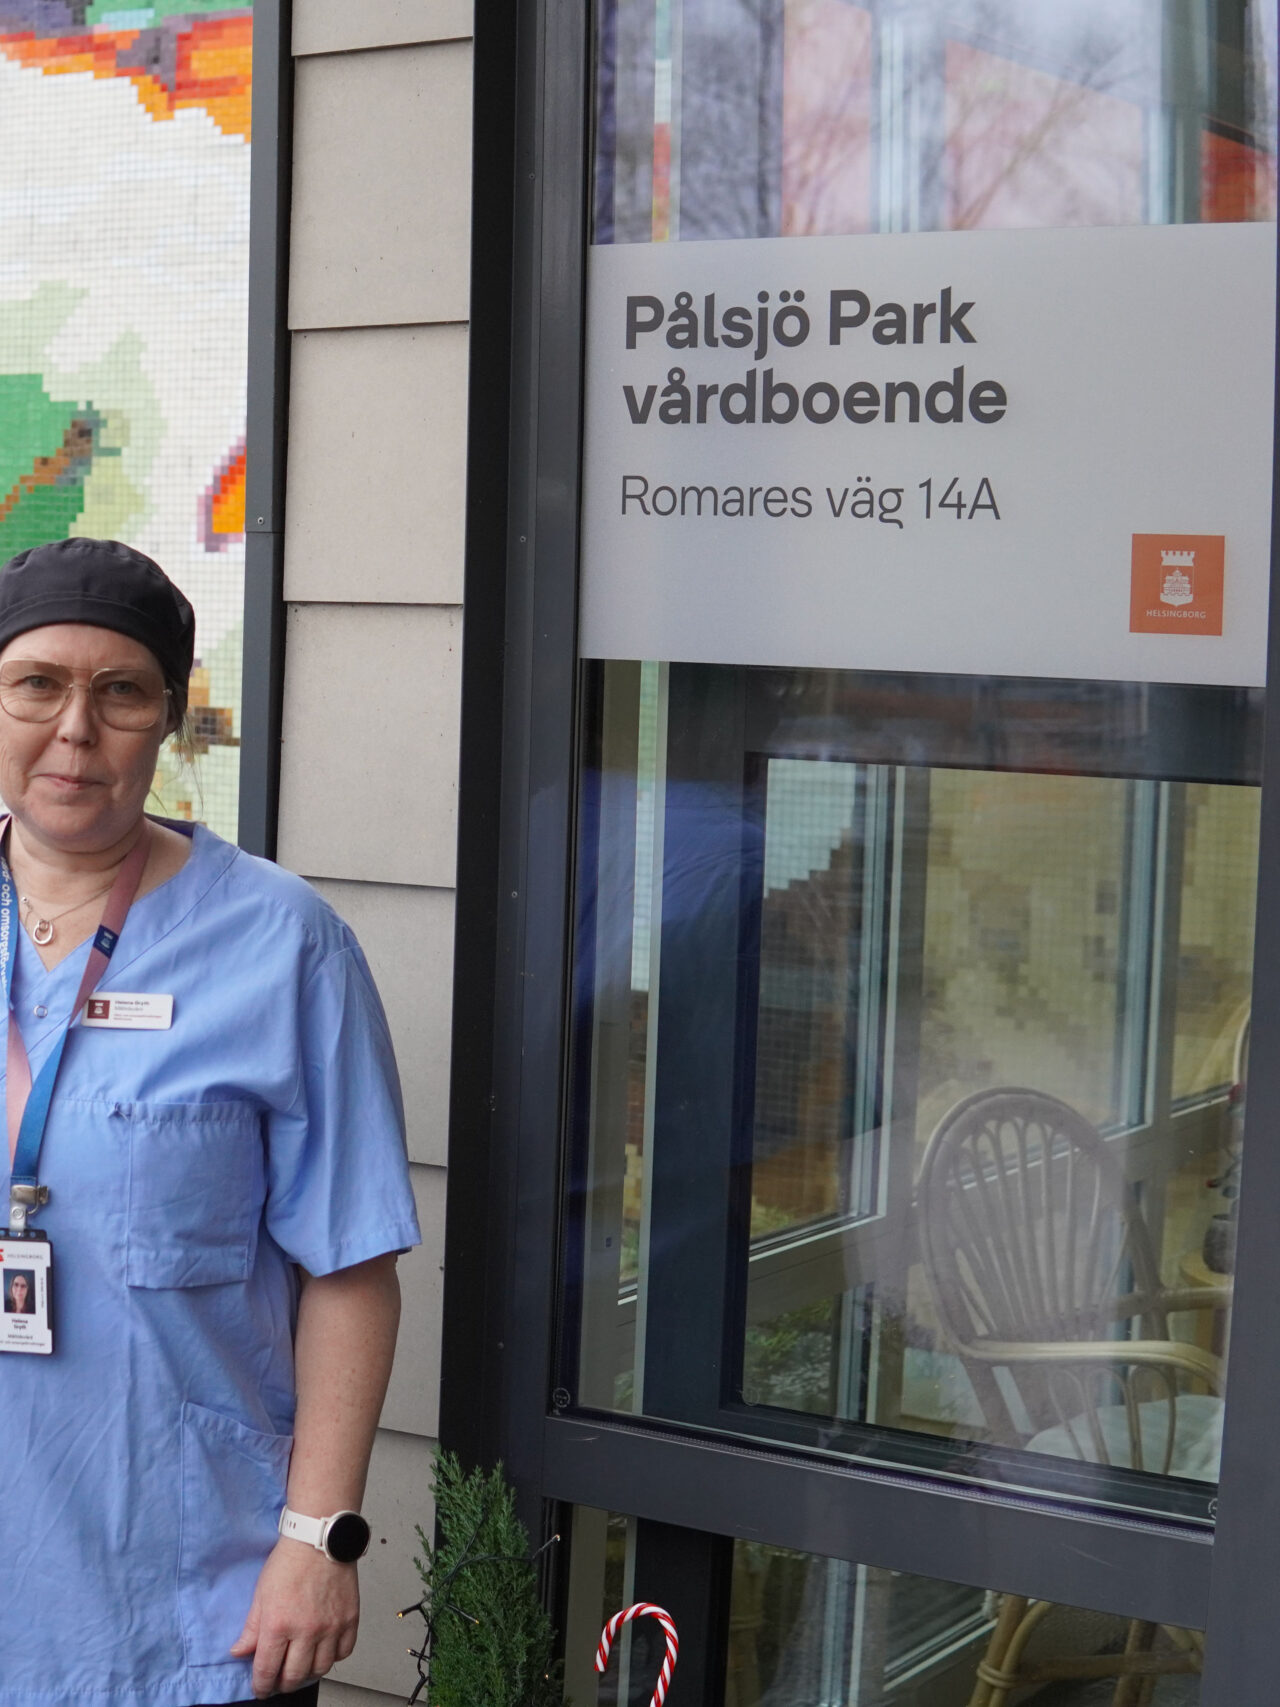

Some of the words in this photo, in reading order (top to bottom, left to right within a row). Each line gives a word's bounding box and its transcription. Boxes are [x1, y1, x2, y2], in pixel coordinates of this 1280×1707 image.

[625, 289, 811, 361] Pålsjö
[829, 286, 978, 346] Park
[622, 364, 1009, 426] vårdboende
[620, 475, 813, 519] Romares
[825, 476, 905, 530] väg
[918, 476, 1002, 521] 14A
[1145, 608, 1207, 620] HELSINGBORG
[1, 883, 13, 906] och
